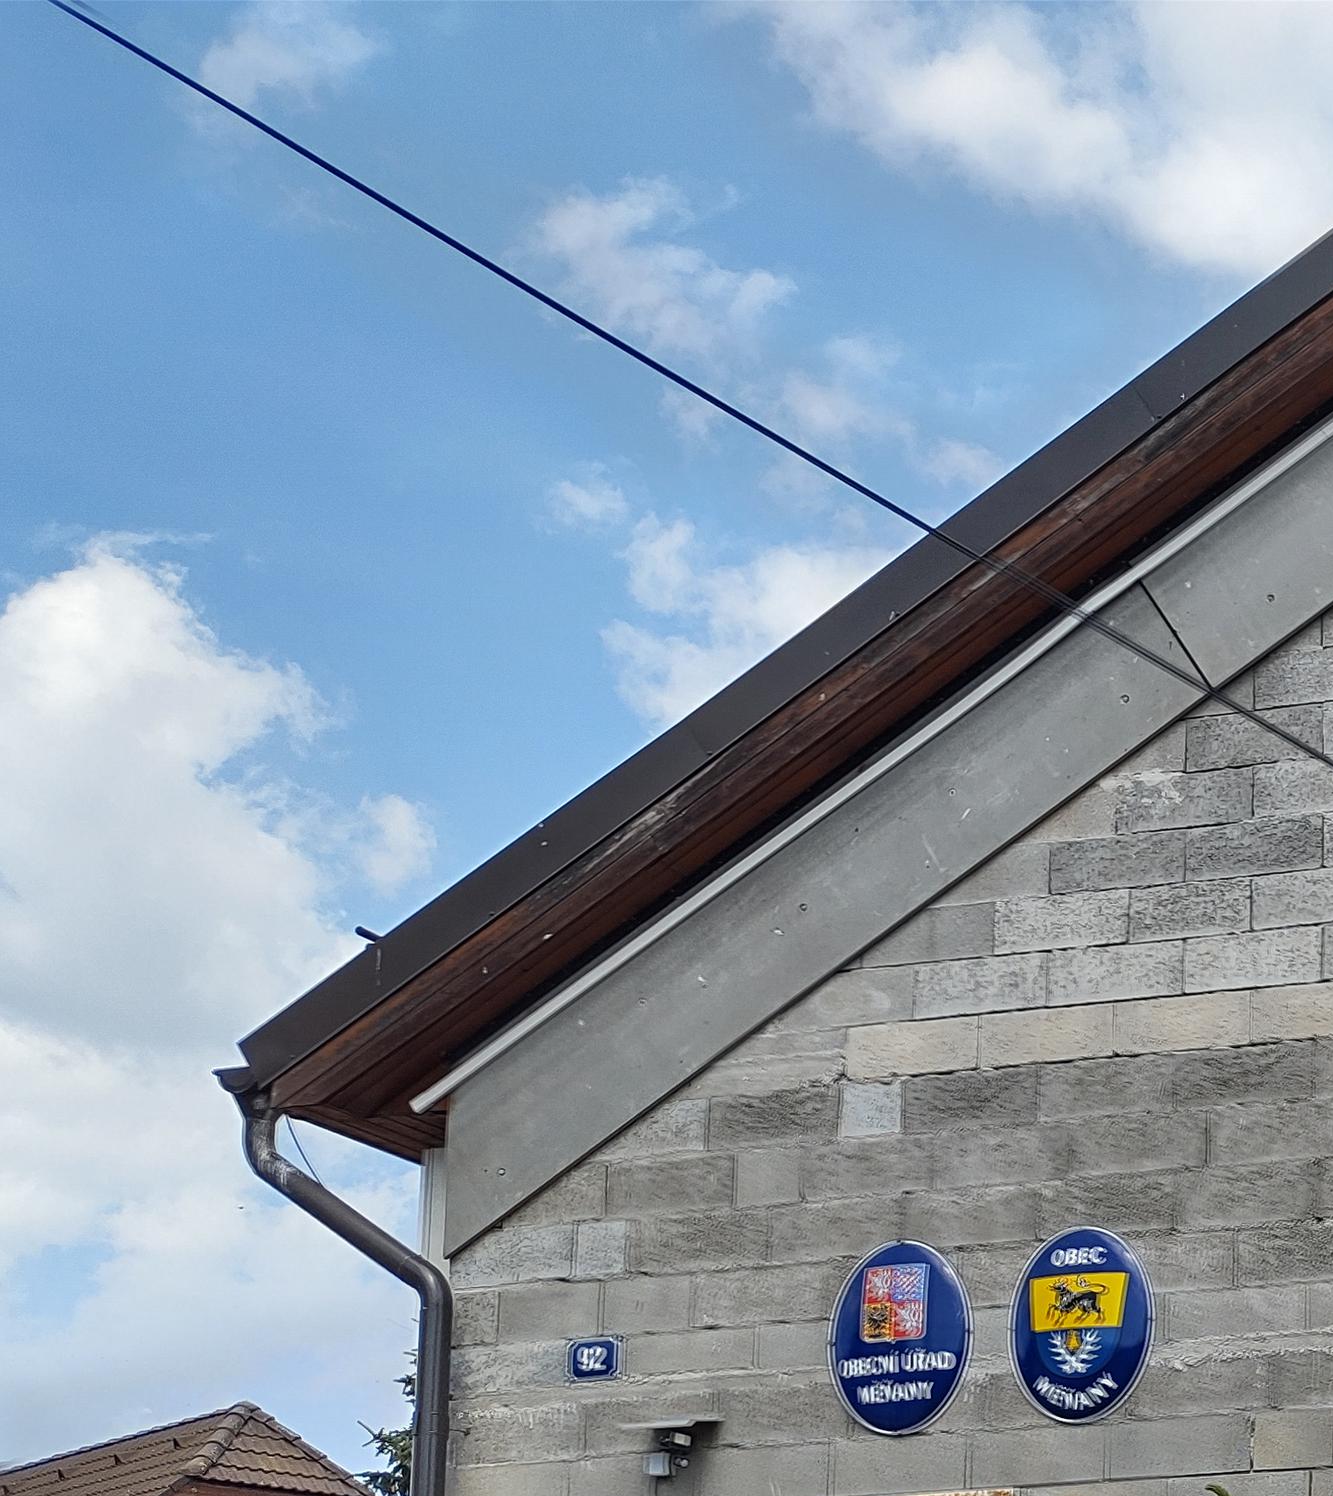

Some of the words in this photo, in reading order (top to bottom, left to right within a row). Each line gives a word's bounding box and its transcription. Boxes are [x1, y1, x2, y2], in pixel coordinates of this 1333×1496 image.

[1050, 1247, 1108, 1268] OBEC
[576, 1345, 608, 1371] 92
[838, 1348, 900, 1379] OBECNÍ
[900, 1346, 957, 1373] ÚŘAD
[856, 1378, 935, 1405] MĚŇANY
[1033, 1371, 1119, 1411] MĚŇANY
